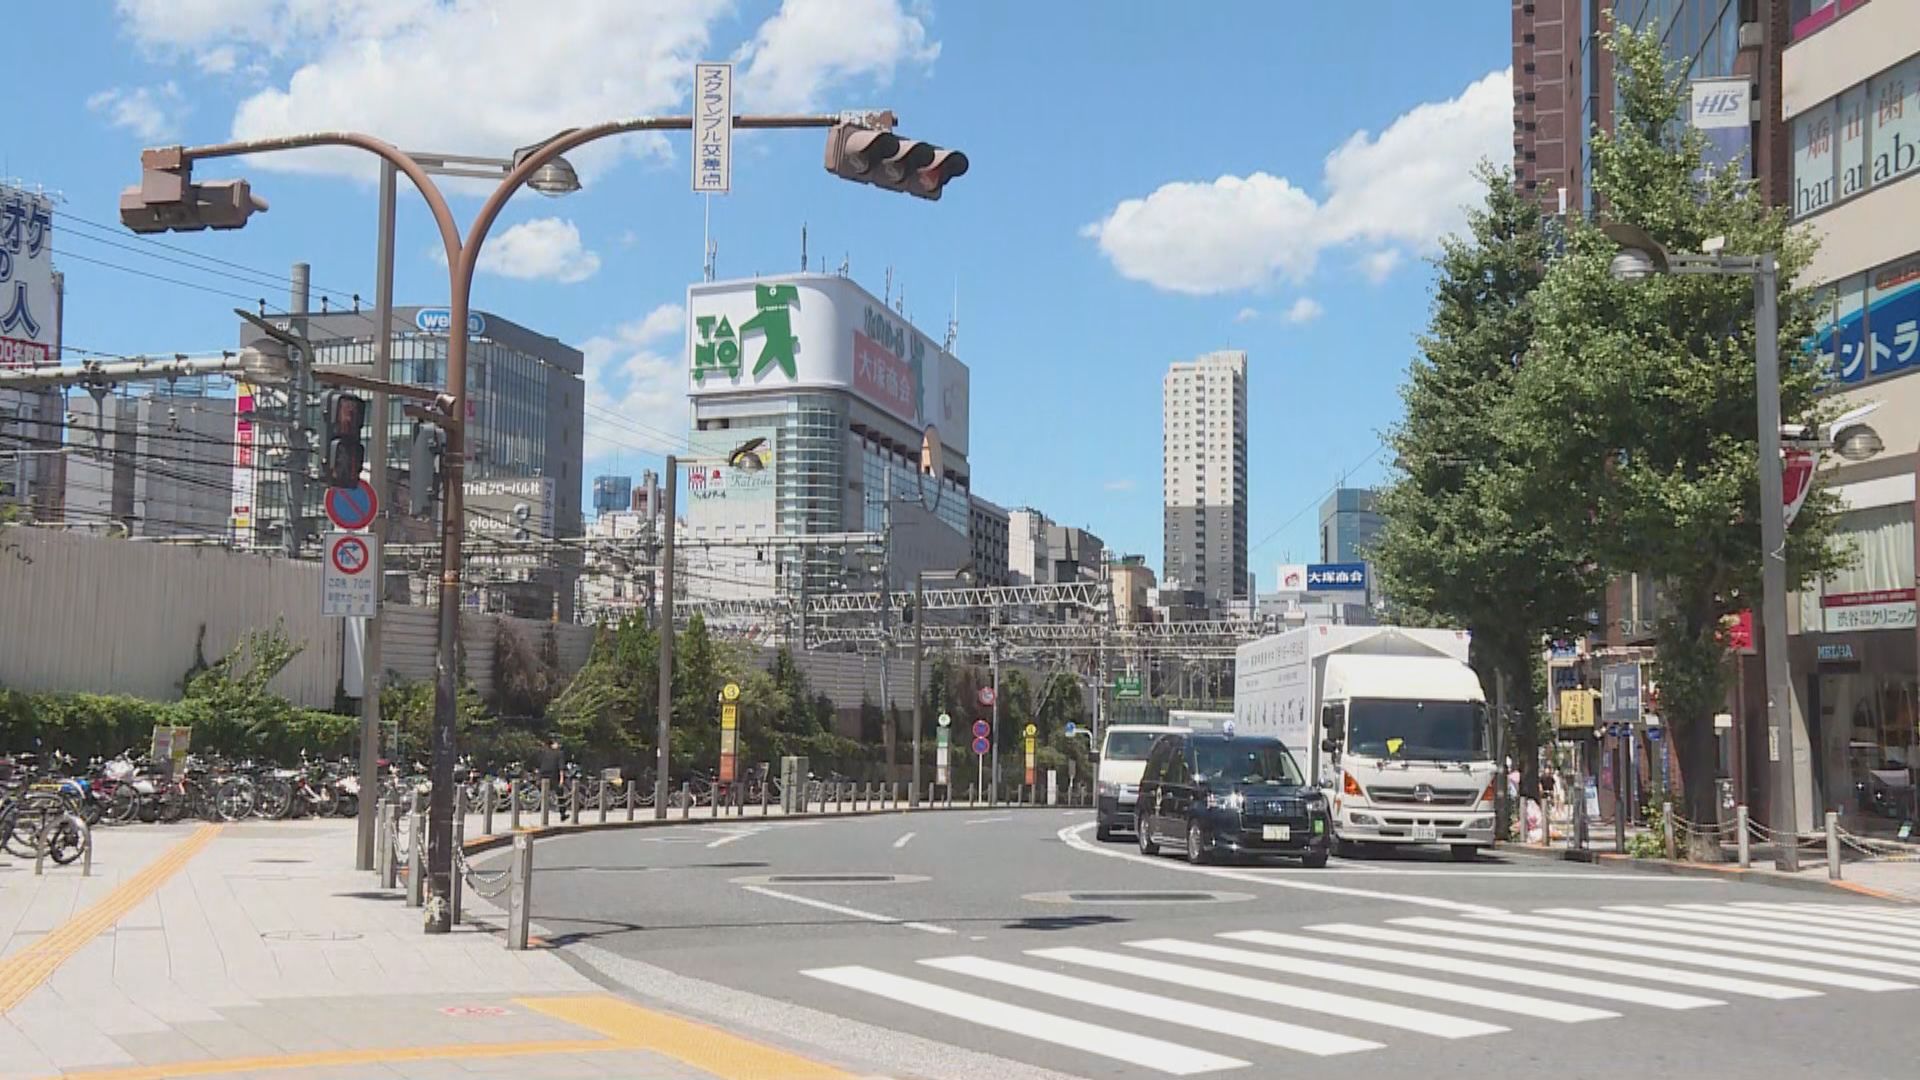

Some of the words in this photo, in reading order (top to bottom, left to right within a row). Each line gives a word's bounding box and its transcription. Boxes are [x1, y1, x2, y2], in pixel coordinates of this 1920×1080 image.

[1696, 94, 1743, 113] HIS
[703, 68, 724, 187] スクランブル交差点
[1308, 569, 1363, 584] 大塚商会
